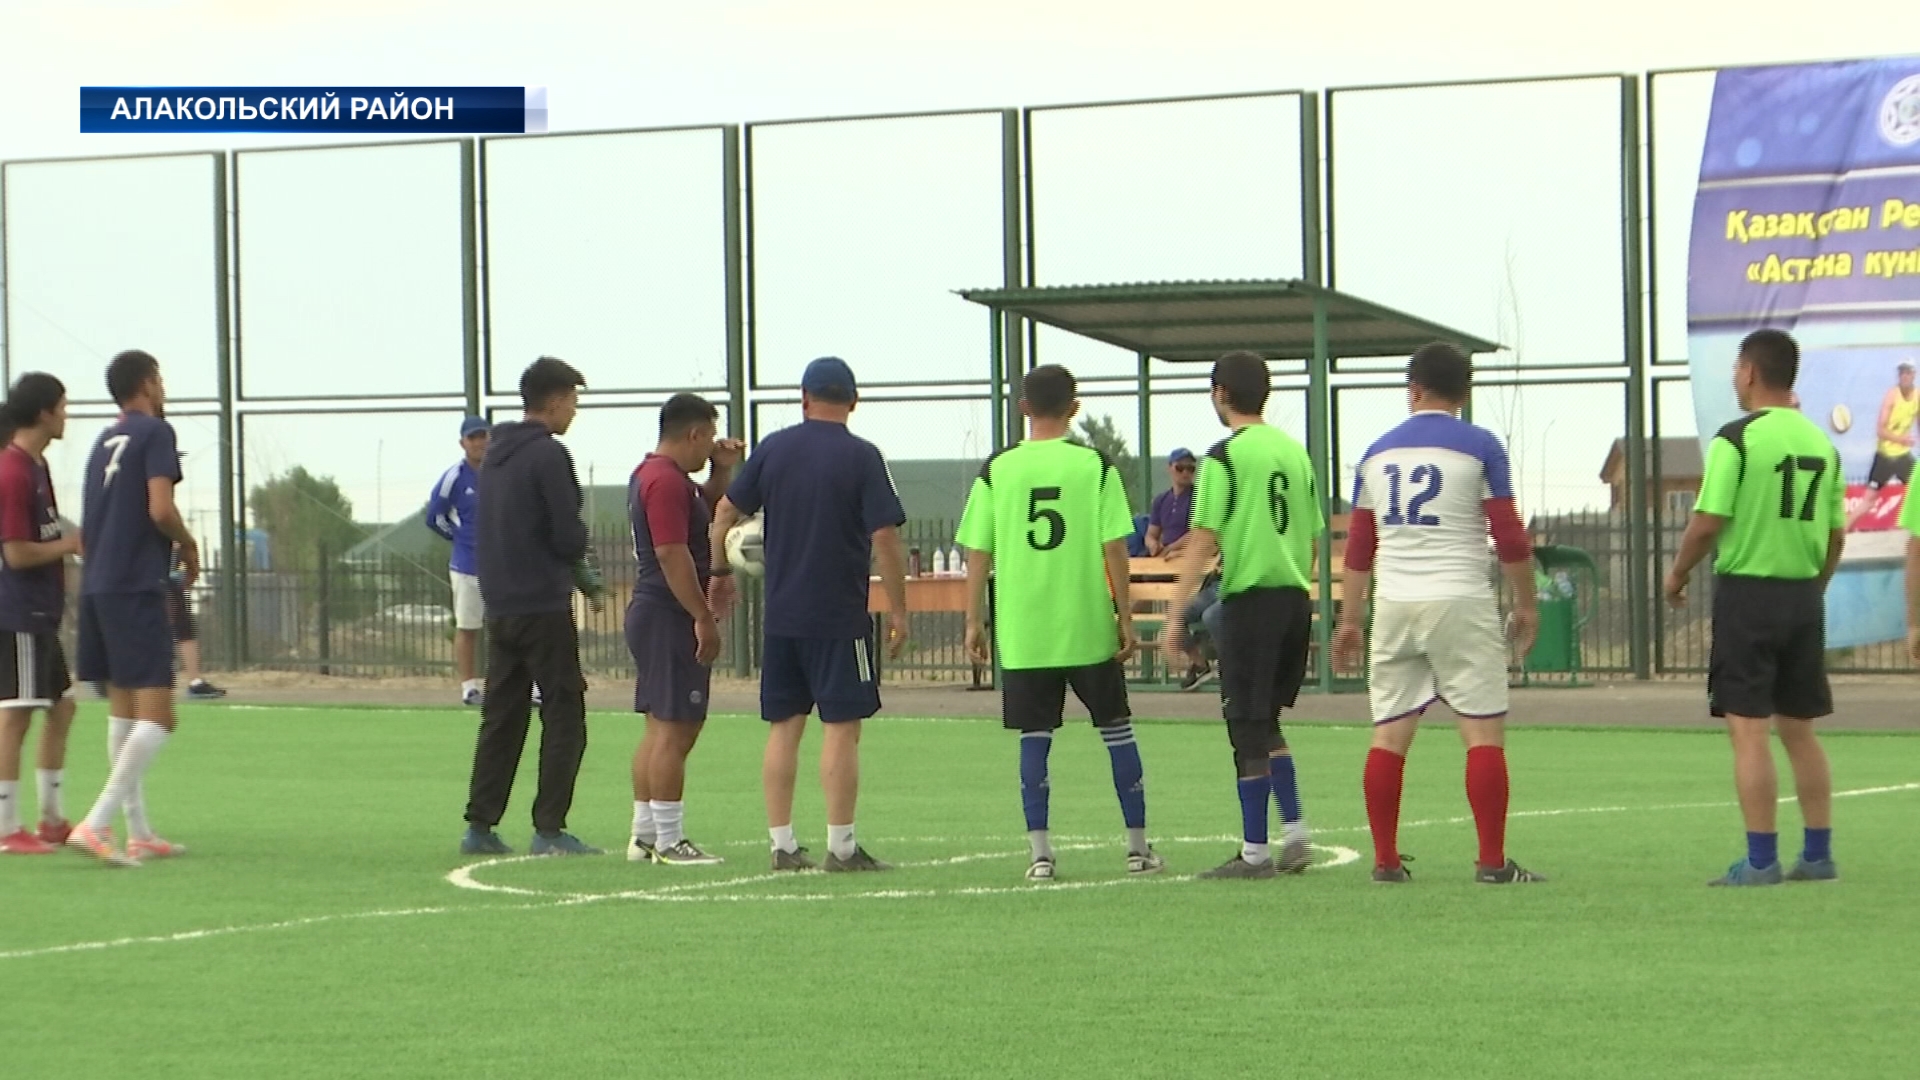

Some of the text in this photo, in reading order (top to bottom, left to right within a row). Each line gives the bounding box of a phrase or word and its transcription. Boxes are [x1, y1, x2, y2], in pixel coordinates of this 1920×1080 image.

[103, 434, 130, 488] 7
[1774, 454, 1827, 521] 17
[1027, 486, 1067, 550] 5
[1267, 471, 1290, 535] 6
[1383, 463, 1441, 526] 12
